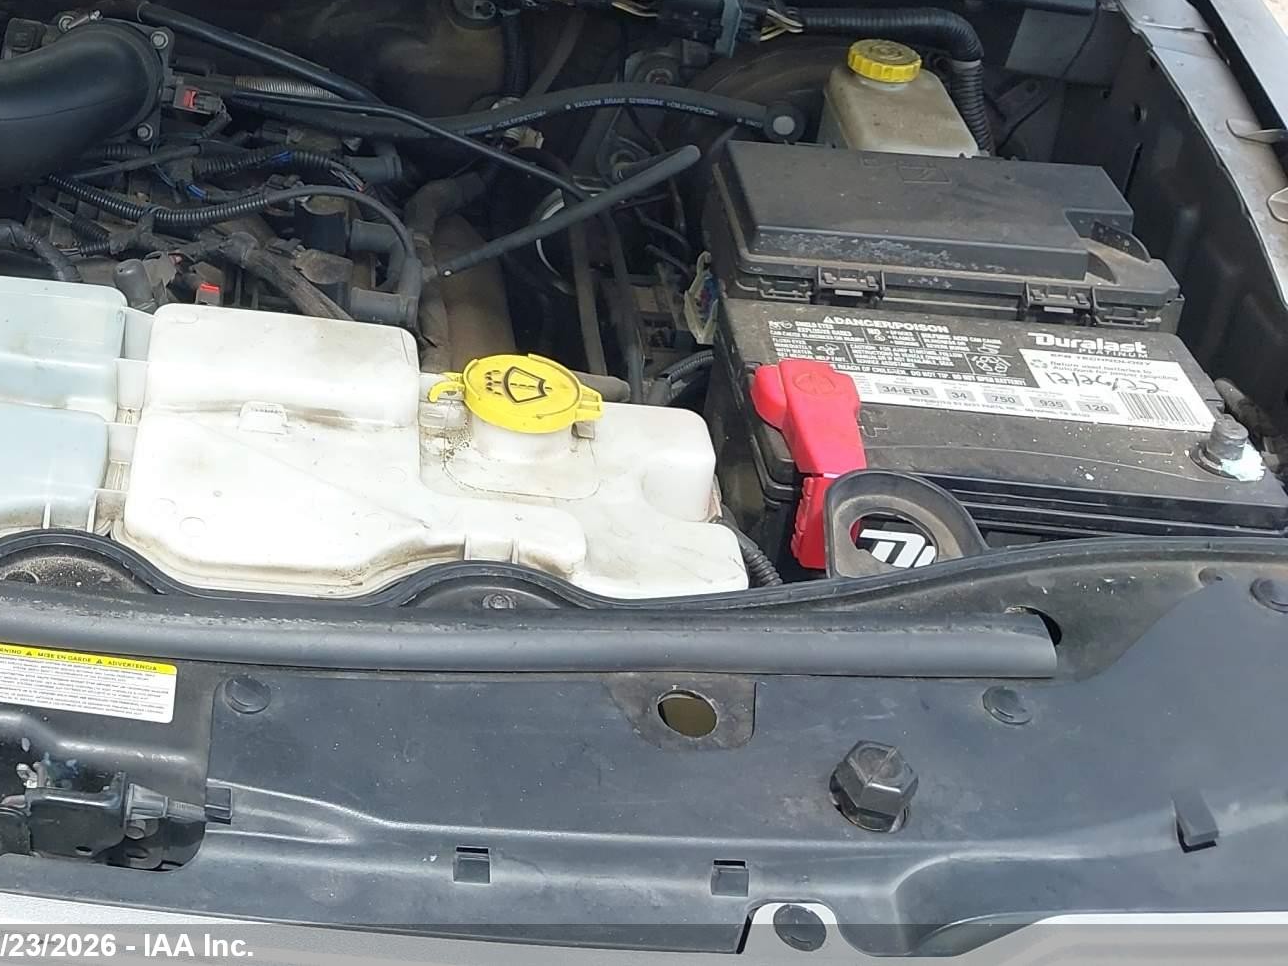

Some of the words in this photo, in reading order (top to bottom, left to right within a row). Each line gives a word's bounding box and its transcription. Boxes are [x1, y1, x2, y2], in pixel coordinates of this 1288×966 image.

[1027, 332, 1148, 354] Duralast
[1078, 348, 1149, 359] PLATINUM
[951, 391, 968, 400] 34
[992, 395, 1016, 405] 750
[1040, 400, 1064, 408] 935
[1085, 404, 1109, 413] 120
[68, 655, 92, 663] GARDE
[108, 660, 158, 672] ADVERTENCIA
